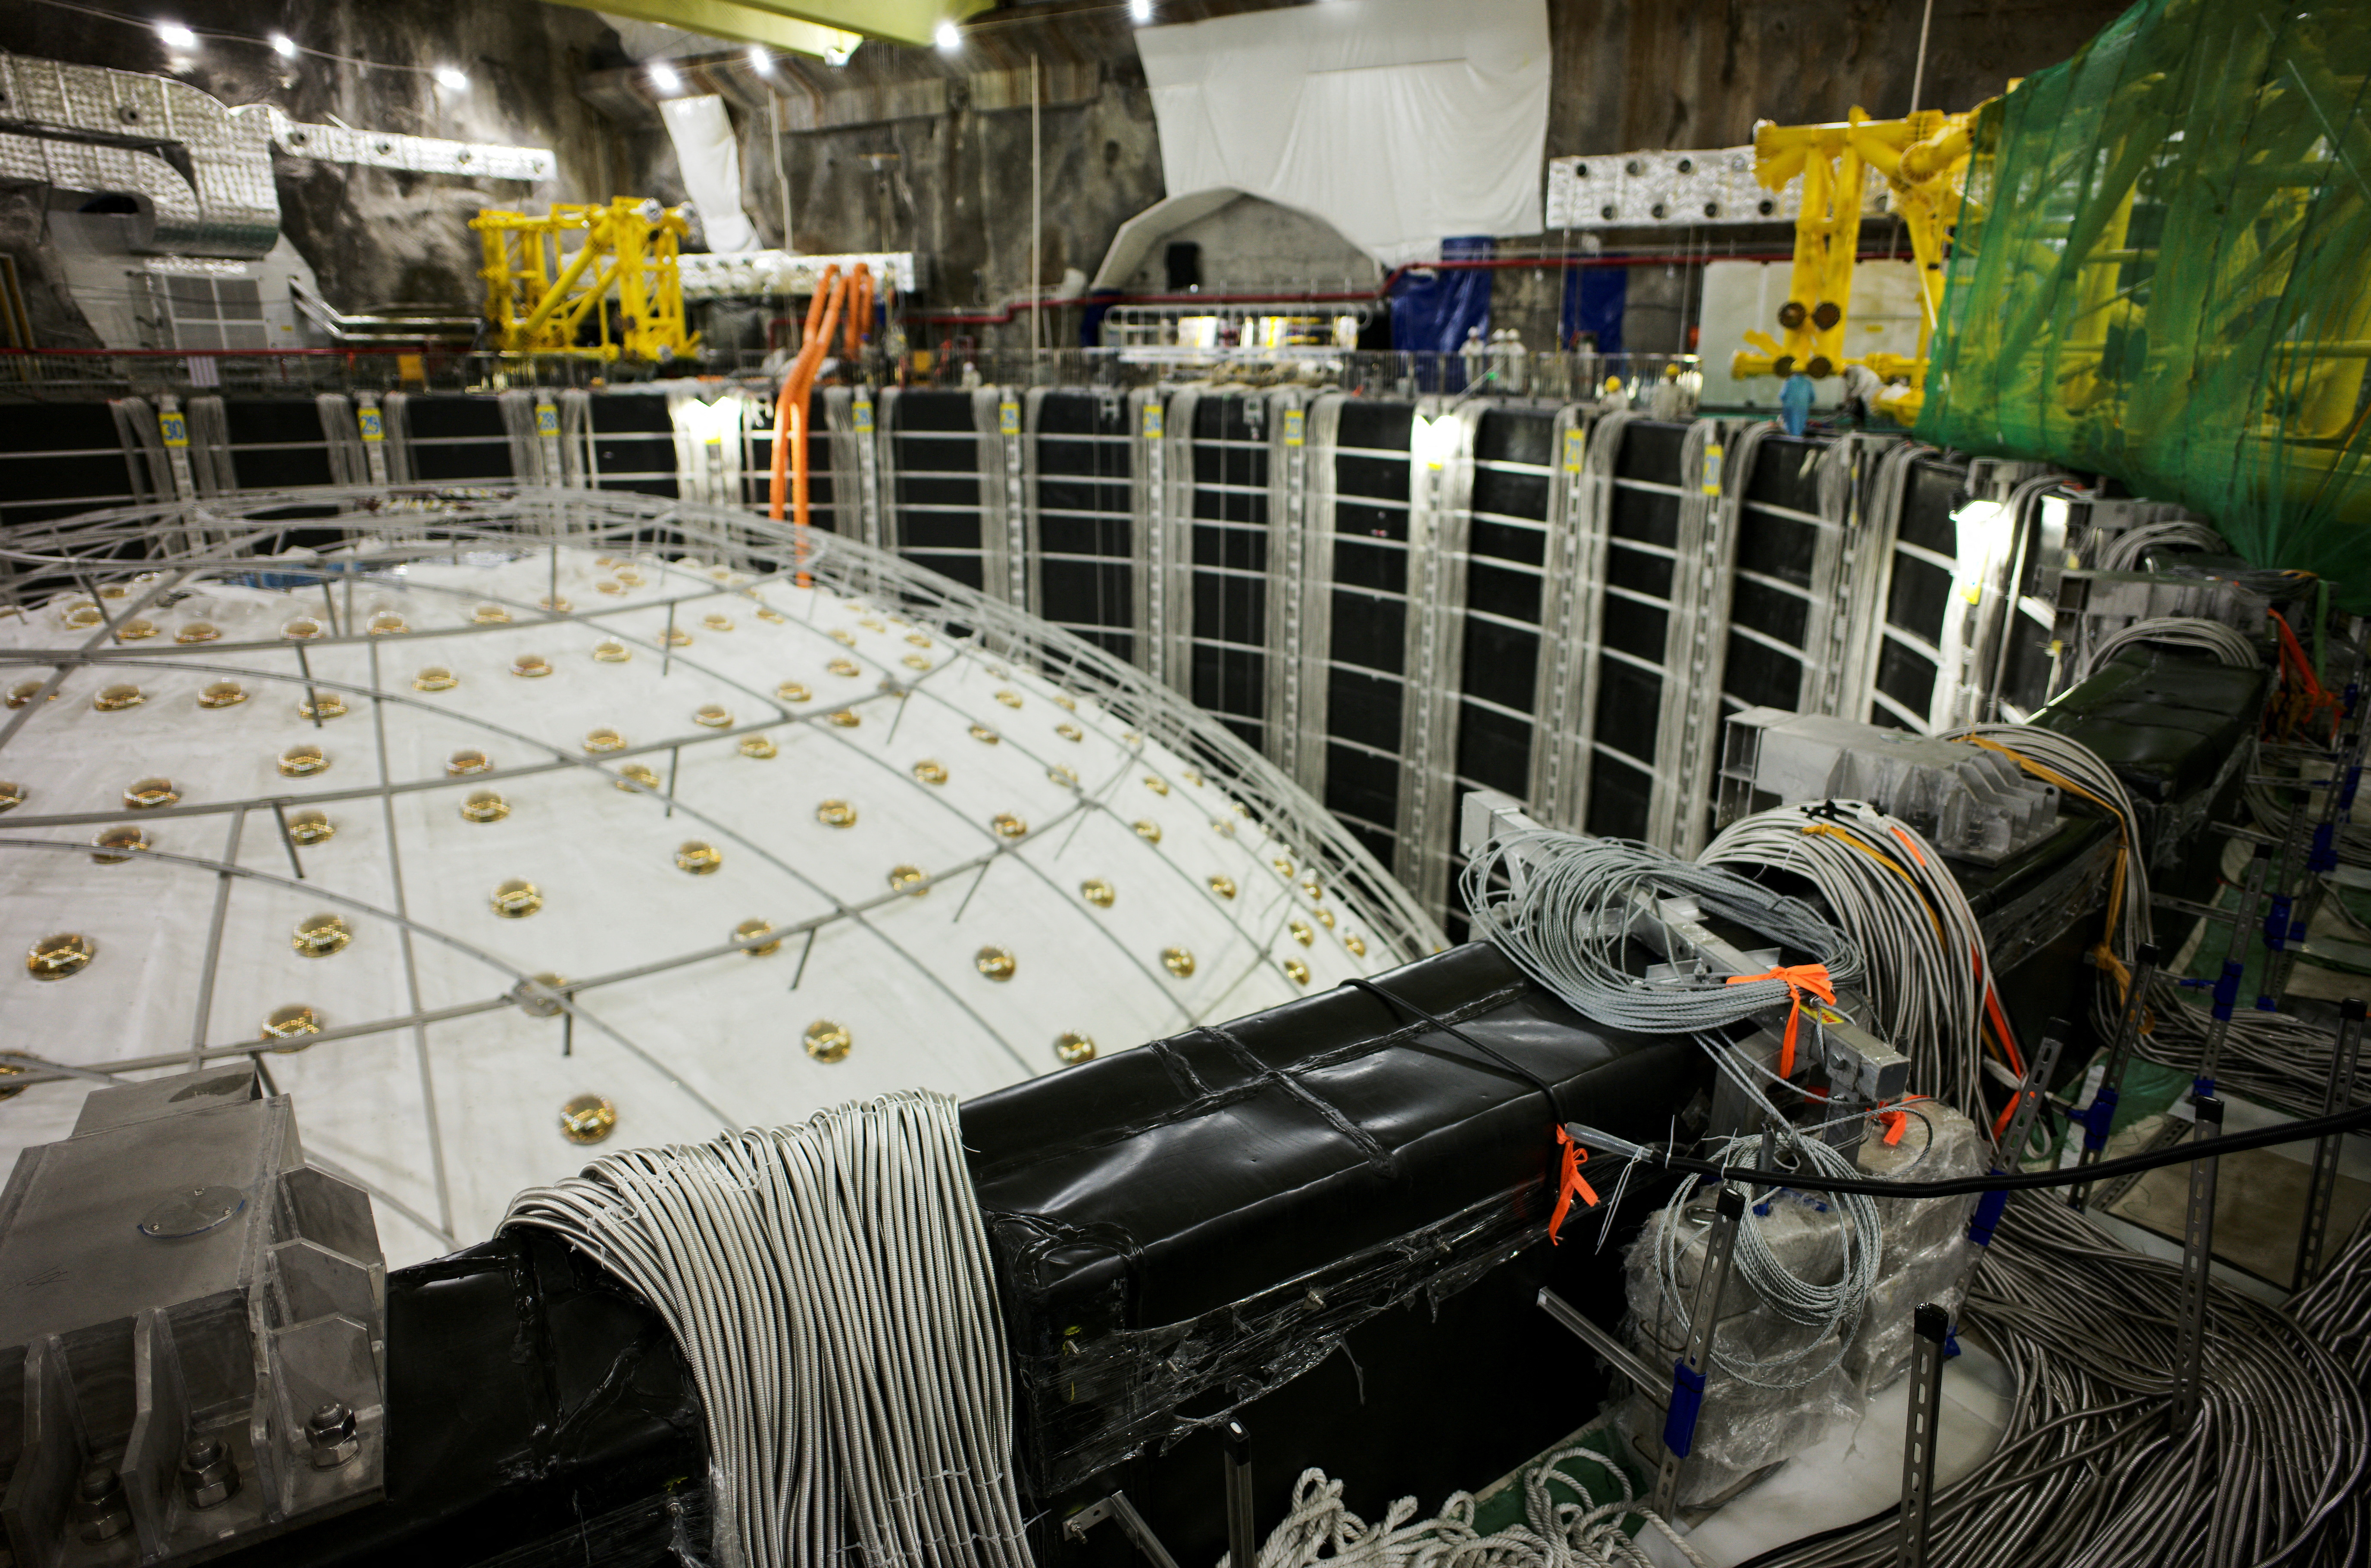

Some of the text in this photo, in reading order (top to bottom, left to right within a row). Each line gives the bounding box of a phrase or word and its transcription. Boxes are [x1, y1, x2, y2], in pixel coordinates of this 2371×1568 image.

[162, 419, 185, 440] 30
[360, 414, 382, 435] 29
[538, 410, 557, 430] 28
